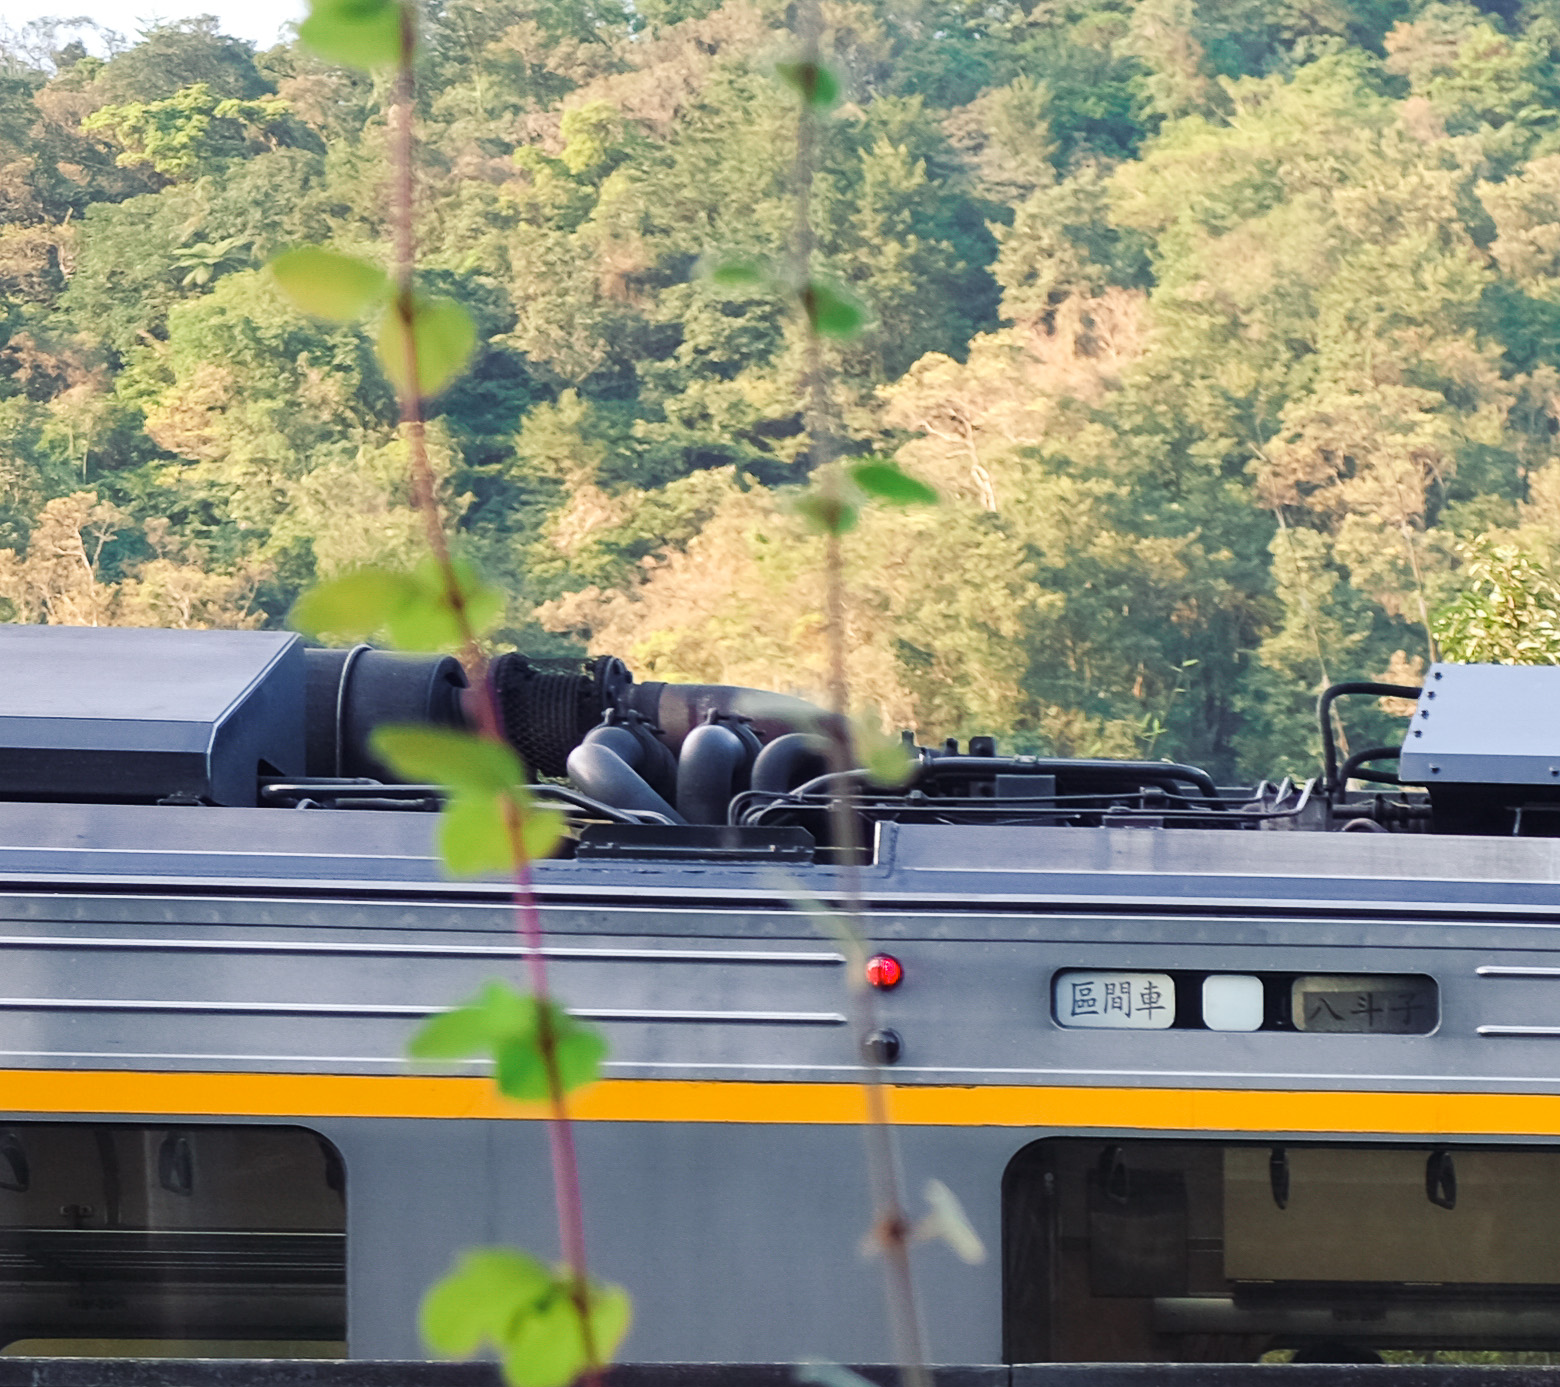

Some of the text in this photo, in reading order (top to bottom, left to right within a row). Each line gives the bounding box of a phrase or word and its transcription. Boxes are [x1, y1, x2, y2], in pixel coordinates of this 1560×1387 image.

[1069, 979, 1167, 1021] 區間車
[1309, 992, 1426, 1027] 八斗子
